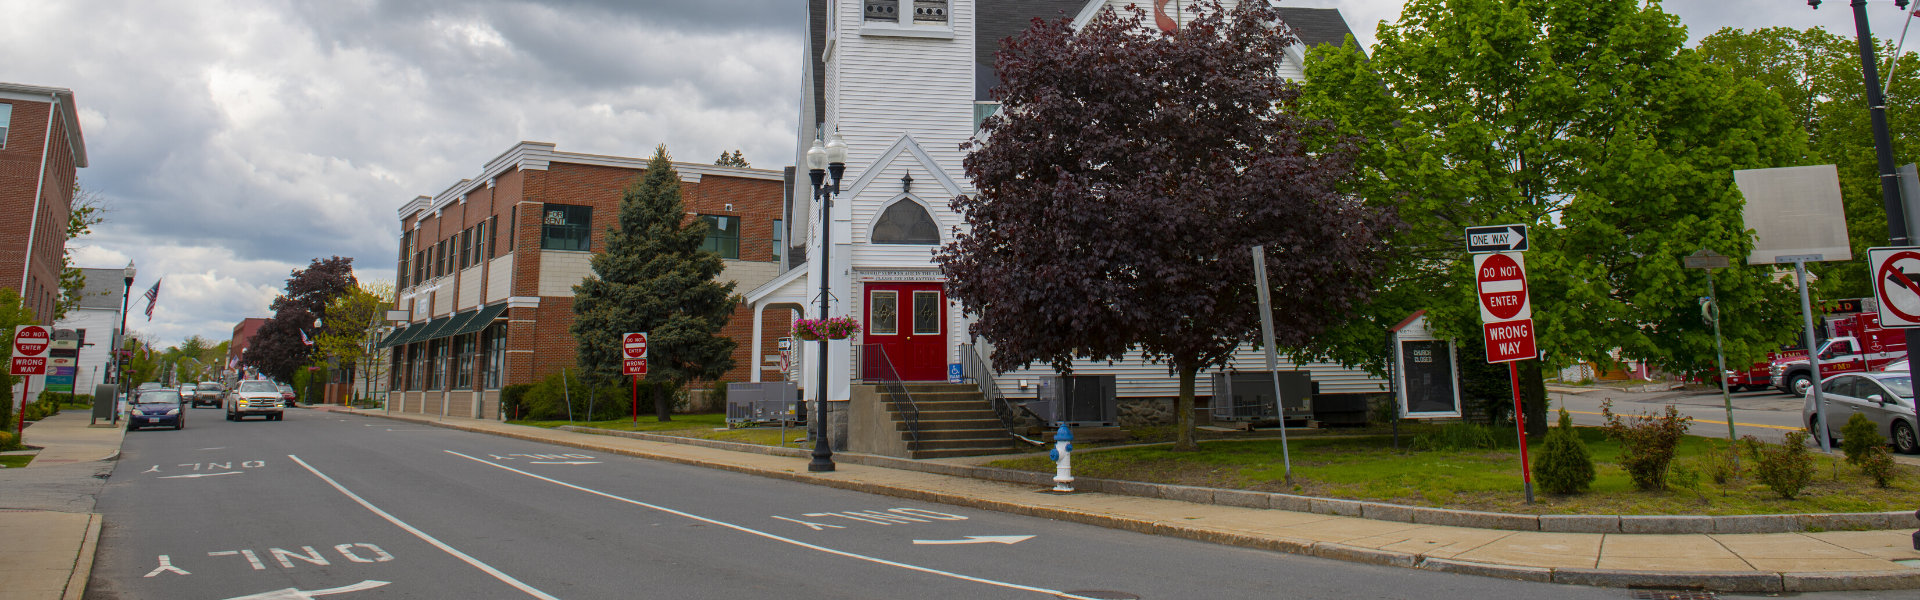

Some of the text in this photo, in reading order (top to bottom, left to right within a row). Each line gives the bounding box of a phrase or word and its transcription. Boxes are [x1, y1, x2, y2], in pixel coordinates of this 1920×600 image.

[544, 217, 565, 225] RENT
[1472, 233, 1509, 246] ONE WAY
[1483, 265, 1517, 279] DO NOT
[1490, 294, 1518, 308] ENTER
[1489, 325, 1528, 341] WRONG
[1498, 341, 1521, 356] WAY
[141, 460, 265, 474] ONLY
[771, 507, 969, 531] ONLY
[143, 542, 395, 578] ONLY
